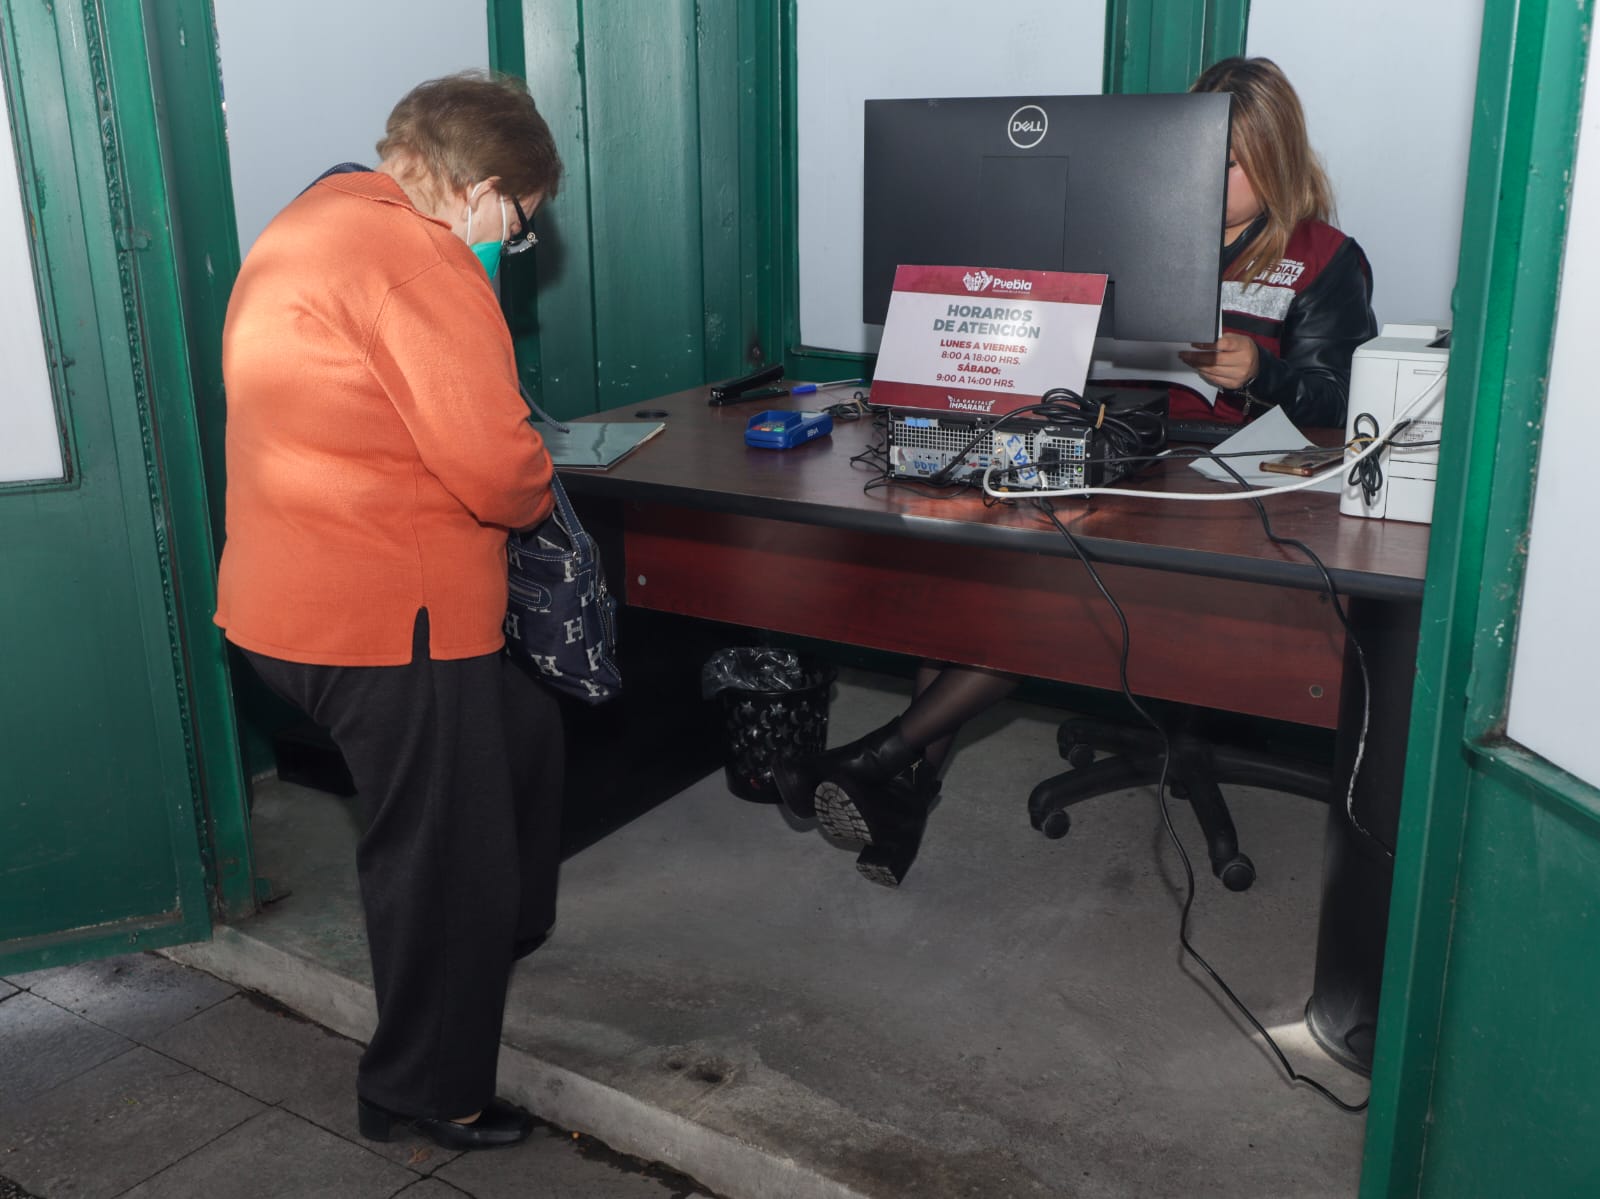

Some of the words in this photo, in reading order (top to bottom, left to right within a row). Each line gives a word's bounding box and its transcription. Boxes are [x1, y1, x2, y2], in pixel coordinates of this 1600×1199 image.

[1013, 120, 1043, 132] DELL
[993, 278, 1032, 290] Puebla
[947, 304, 1033, 321] HORARIOS
[933, 319, 955, 332] DE
[957, 321, 1040, 338] ATENCIÓN
[940, 339, 971, 349] LUNES
[973, 341, 980, 350] A
[983, 342, 1027, 353] VIERNES:
[941, 350, 961, 360] 8:00
[963, 353, 970, 361] A
[973, 353, 997, 362] 18:00
[999, 356, 1020, 365] HRS.
[957, 362, 1001, 374] SÁBADO:
[936, 373, 957, 383] 9:00
[958, 376, 965, 384] A
[967, 376, 991, 386] 14:00
[993, 379, 1015, 388] HRS.
[950, 402, 992, 412] IMPARABLE
